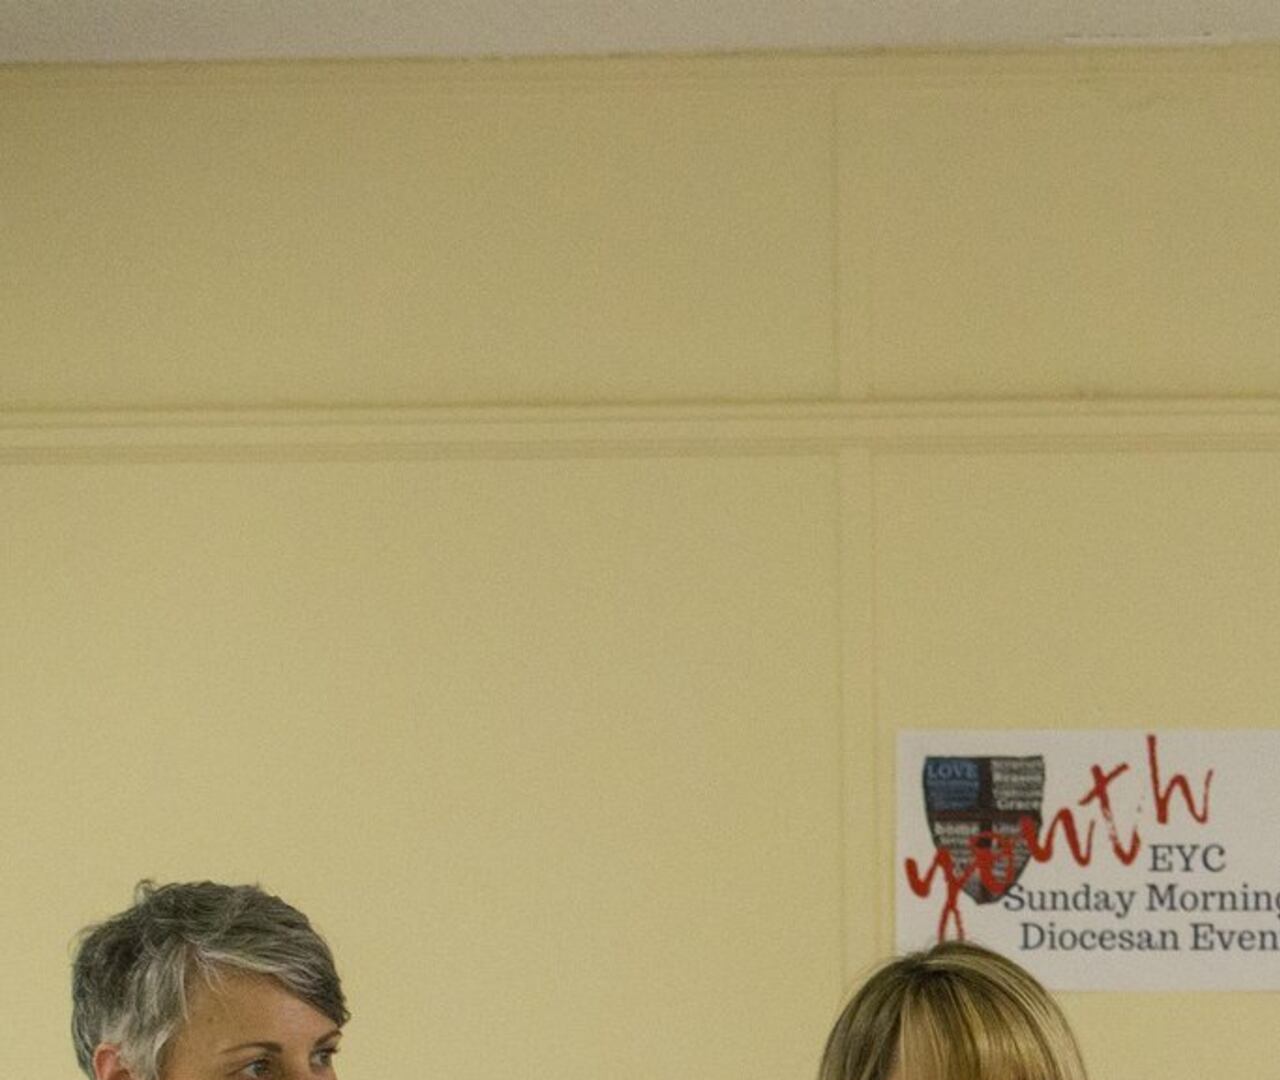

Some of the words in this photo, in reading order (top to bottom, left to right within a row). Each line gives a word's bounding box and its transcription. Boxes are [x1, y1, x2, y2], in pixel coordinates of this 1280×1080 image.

[1148, 844, 1227, 873] EYC
[1002, 884, 1136, 919] Sunday
[1020, 923, 1180, 951] Diocesan
